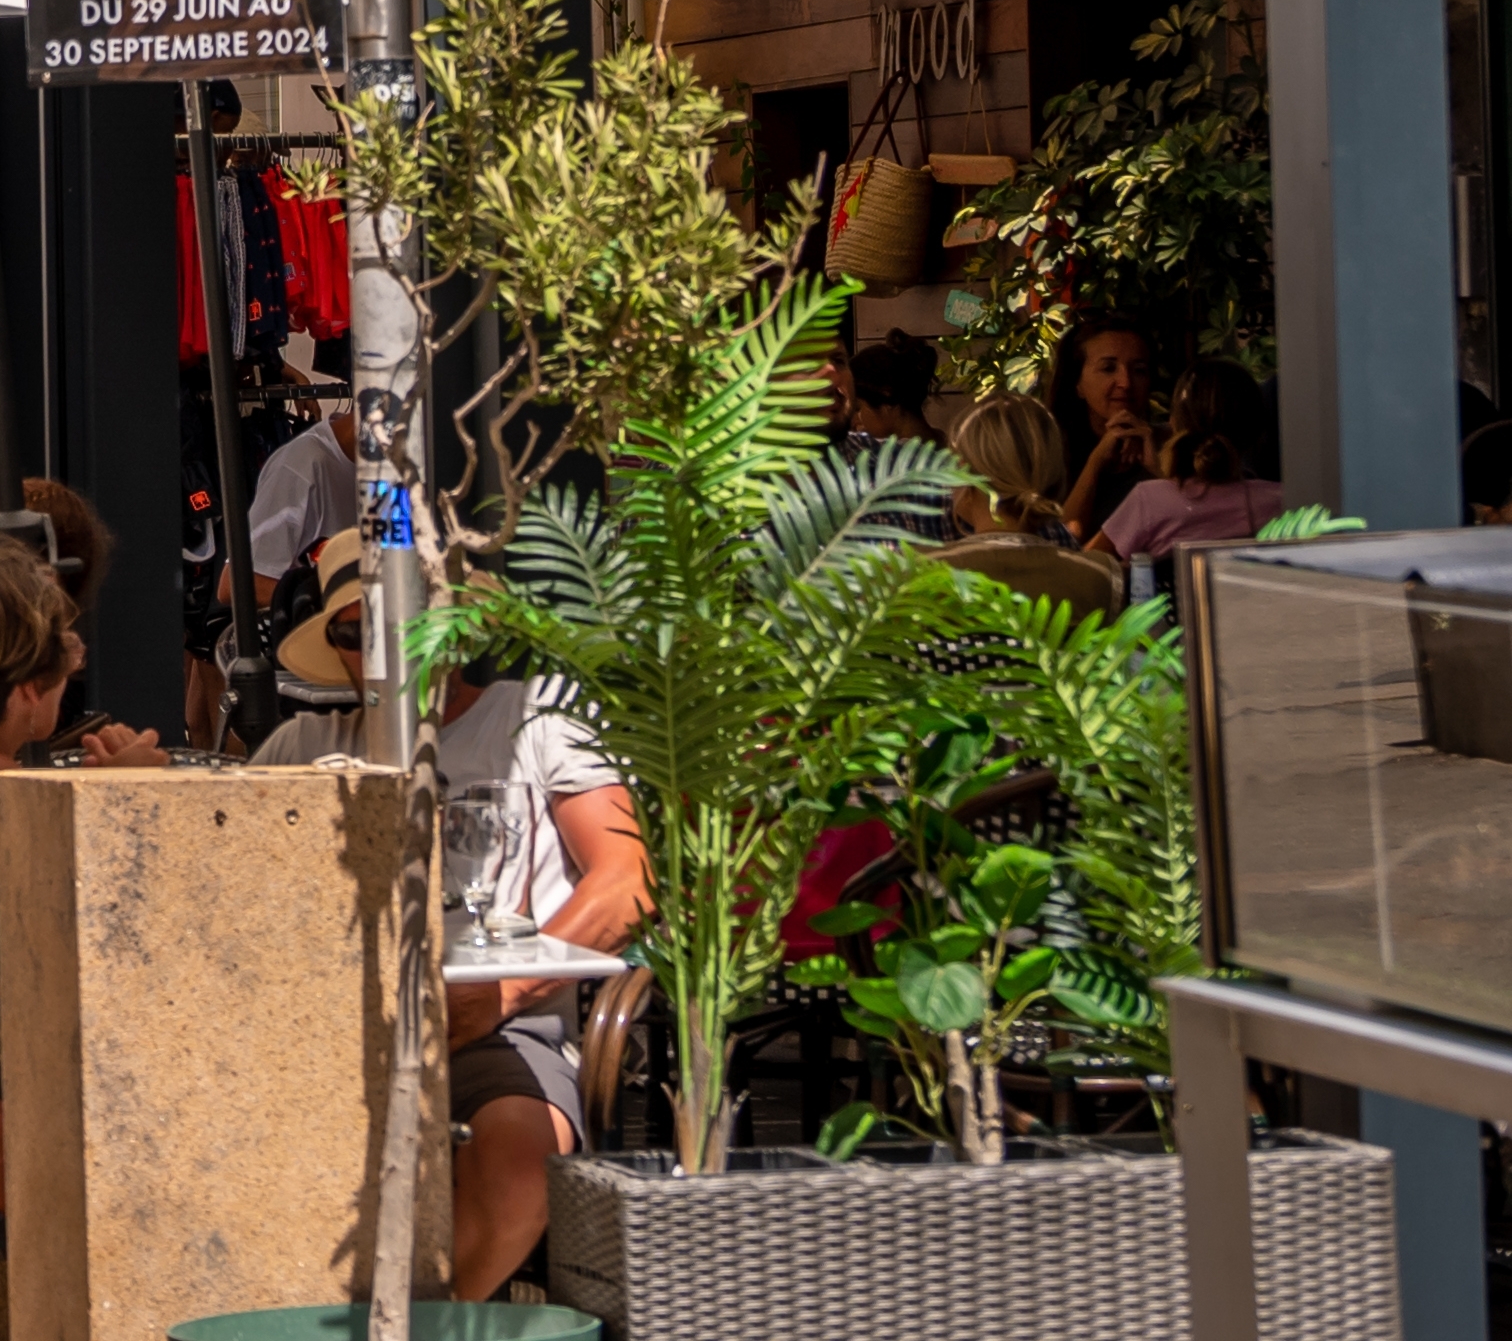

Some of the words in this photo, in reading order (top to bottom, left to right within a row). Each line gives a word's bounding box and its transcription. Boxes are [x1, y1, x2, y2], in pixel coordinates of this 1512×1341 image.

[45, 39, 81, 67] 30
[89, 31, 249, 65] SEPTEMBRE
[256, 26, 328, 55] 2024
